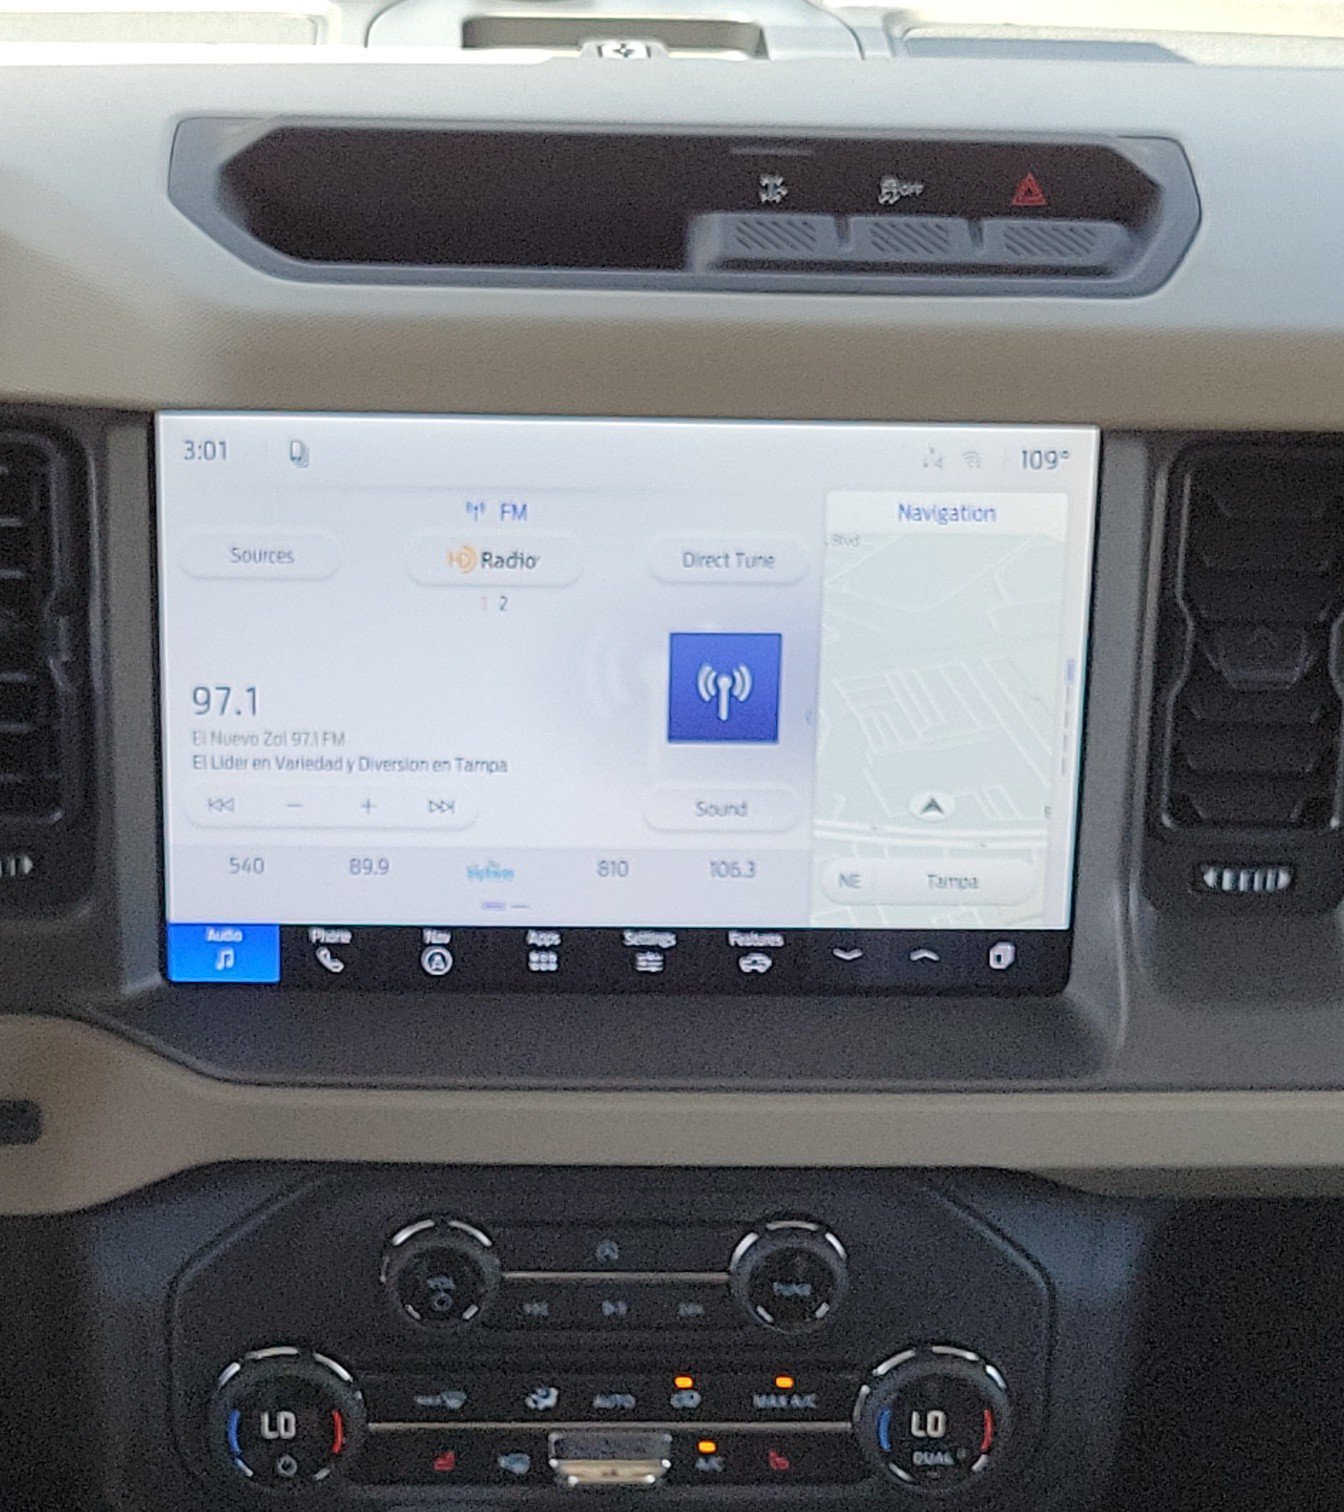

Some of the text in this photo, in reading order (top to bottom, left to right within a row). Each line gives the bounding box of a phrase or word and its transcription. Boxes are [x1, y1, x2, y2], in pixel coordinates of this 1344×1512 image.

[182, 439, 227, 461] 3:01
[1021, 449, 1071, 470] 109°
[500, 503, 529, 522] FM
[898, 504, 997, 525] Navigation
[229, 547, 296, 565] Sources
[480, 550, 539, 570] Radio
[682, 549, 775, 569] Direct Tune
[192, 685, 258, 716] 97.1
[209, 729, 259, 747] Nuevo
[323, 732, 346, 748] FM
[252, 757, 272, 771] en
[275, 755, 343, 771] Variedad
[358, 756, 429, 772] Diversion
[432, 759, 452, 773] en
[454, 757, 508, 774] Tampa
[694, 800, 749, 818] Sound
[229, 857, 265, 875] 540
[349, 857, 390, 876] 89.9
[596, 859, 629, 877] 810
[709, 859, 757, 879] 106.3
[838, 873, 862, 889] NE
[927, 873, 980, 891] Tampa
[206, 927, 244, 943] Audio
